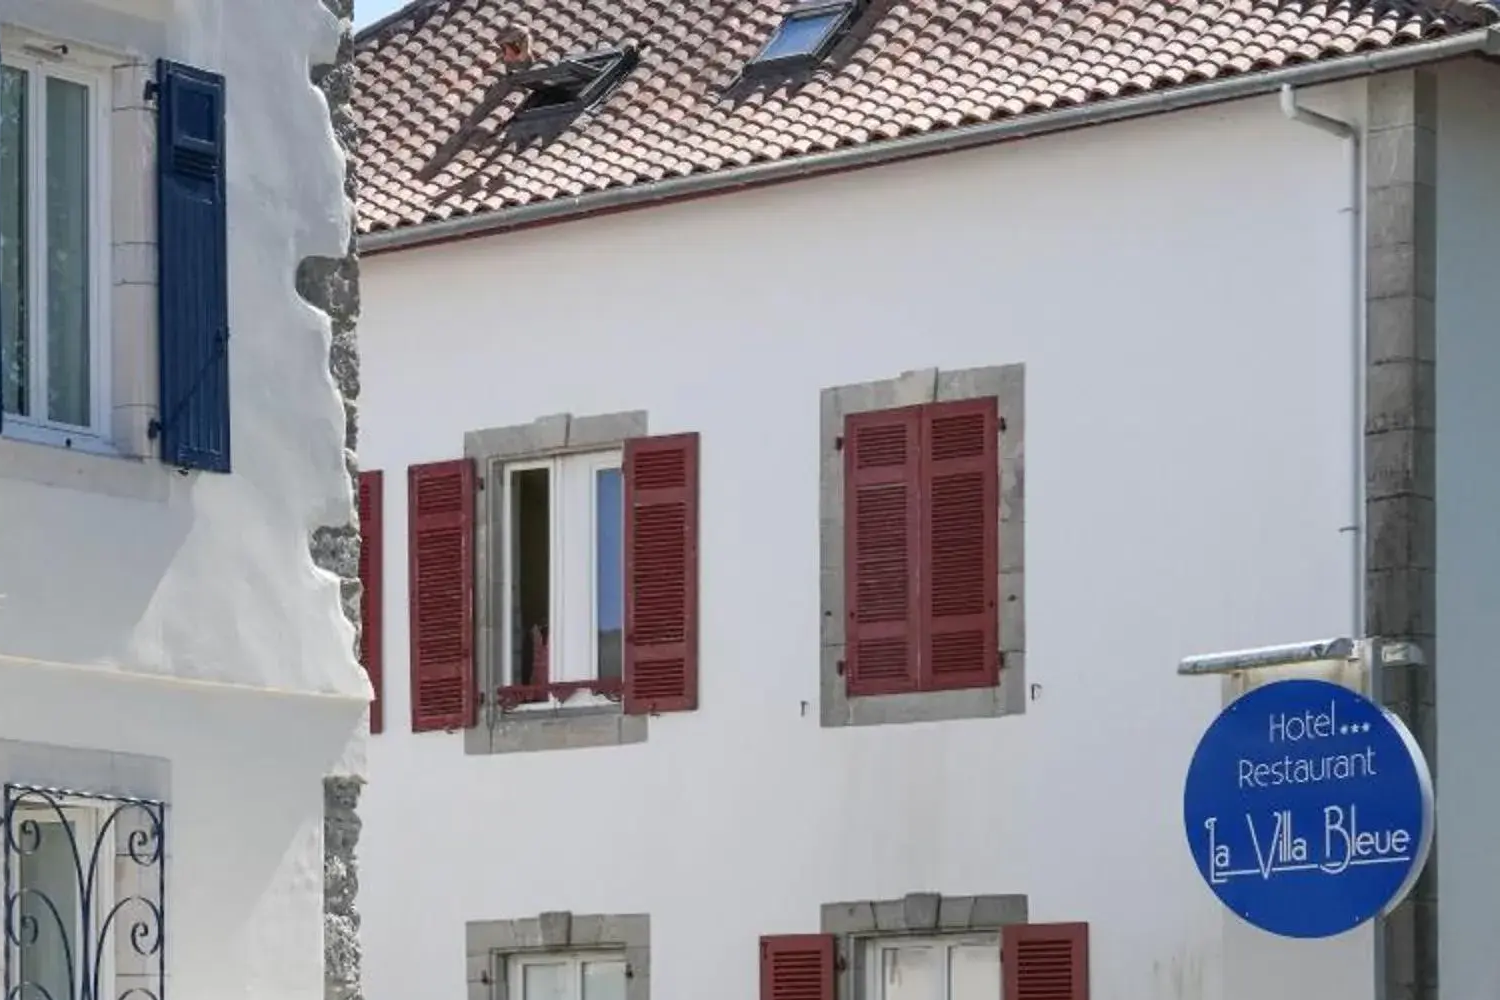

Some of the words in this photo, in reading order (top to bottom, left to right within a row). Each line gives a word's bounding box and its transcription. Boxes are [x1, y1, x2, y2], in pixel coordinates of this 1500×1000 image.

[1269, 699, 1336, 743] Hotel
[1238, 745, 1377, 789] Restaurant
[1204, 816, 1230, 884] La
[1246, 809, 1308, 880] Villa
[1319, 803, 1412, 875] Bleue
